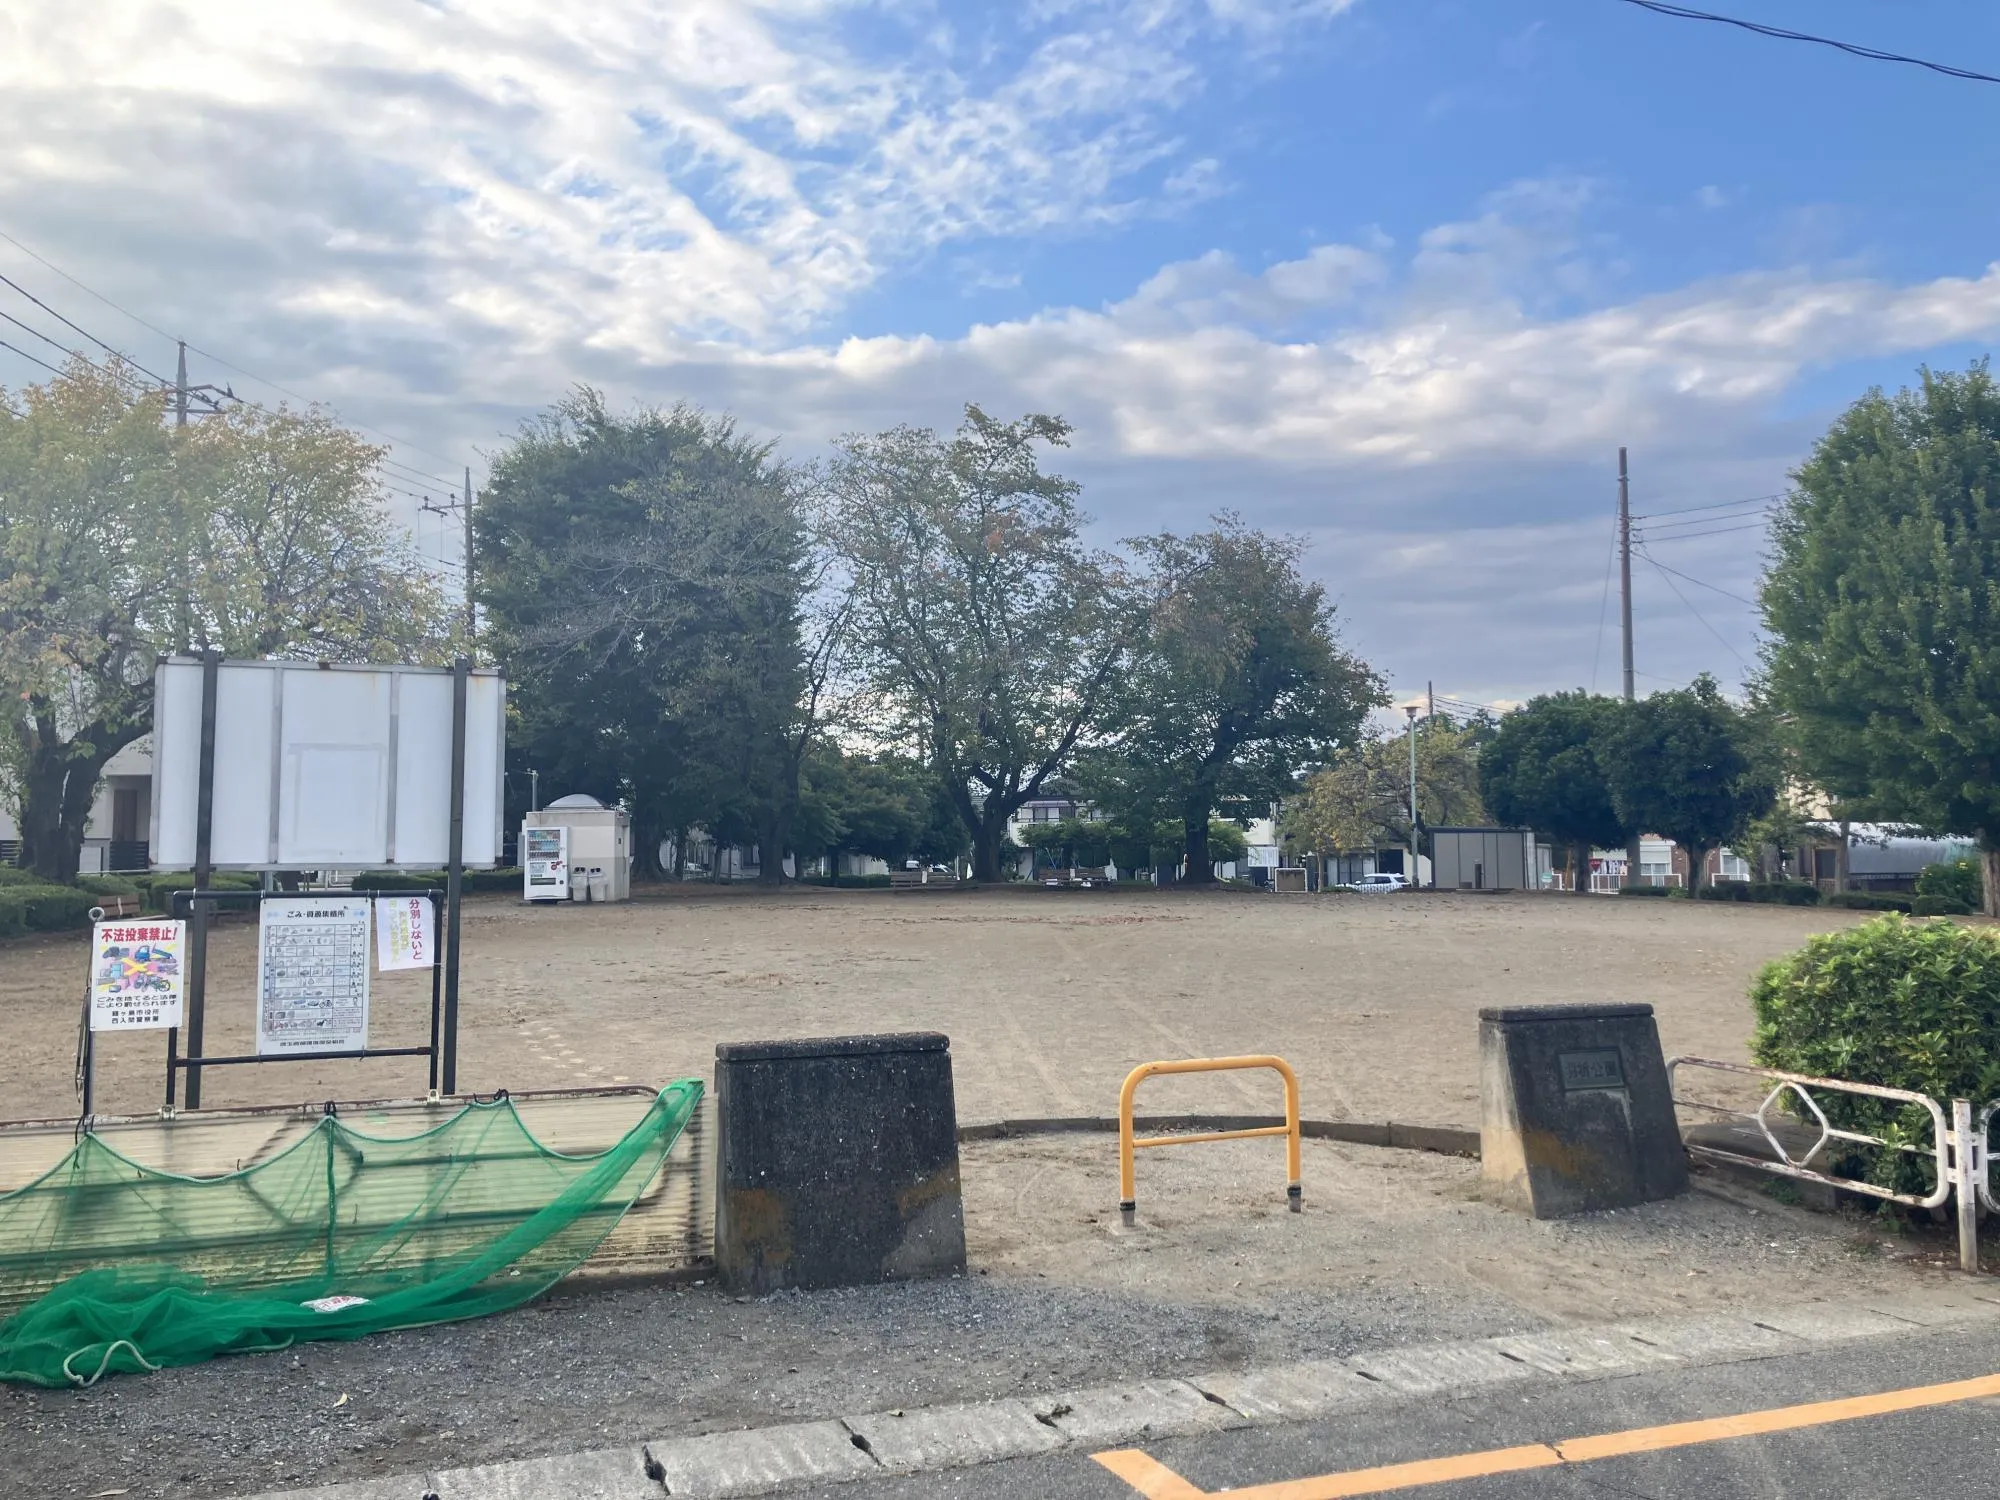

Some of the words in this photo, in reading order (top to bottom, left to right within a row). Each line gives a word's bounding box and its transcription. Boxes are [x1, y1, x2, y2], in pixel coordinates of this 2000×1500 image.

[409, 898, 422, 960] 分別しないと
